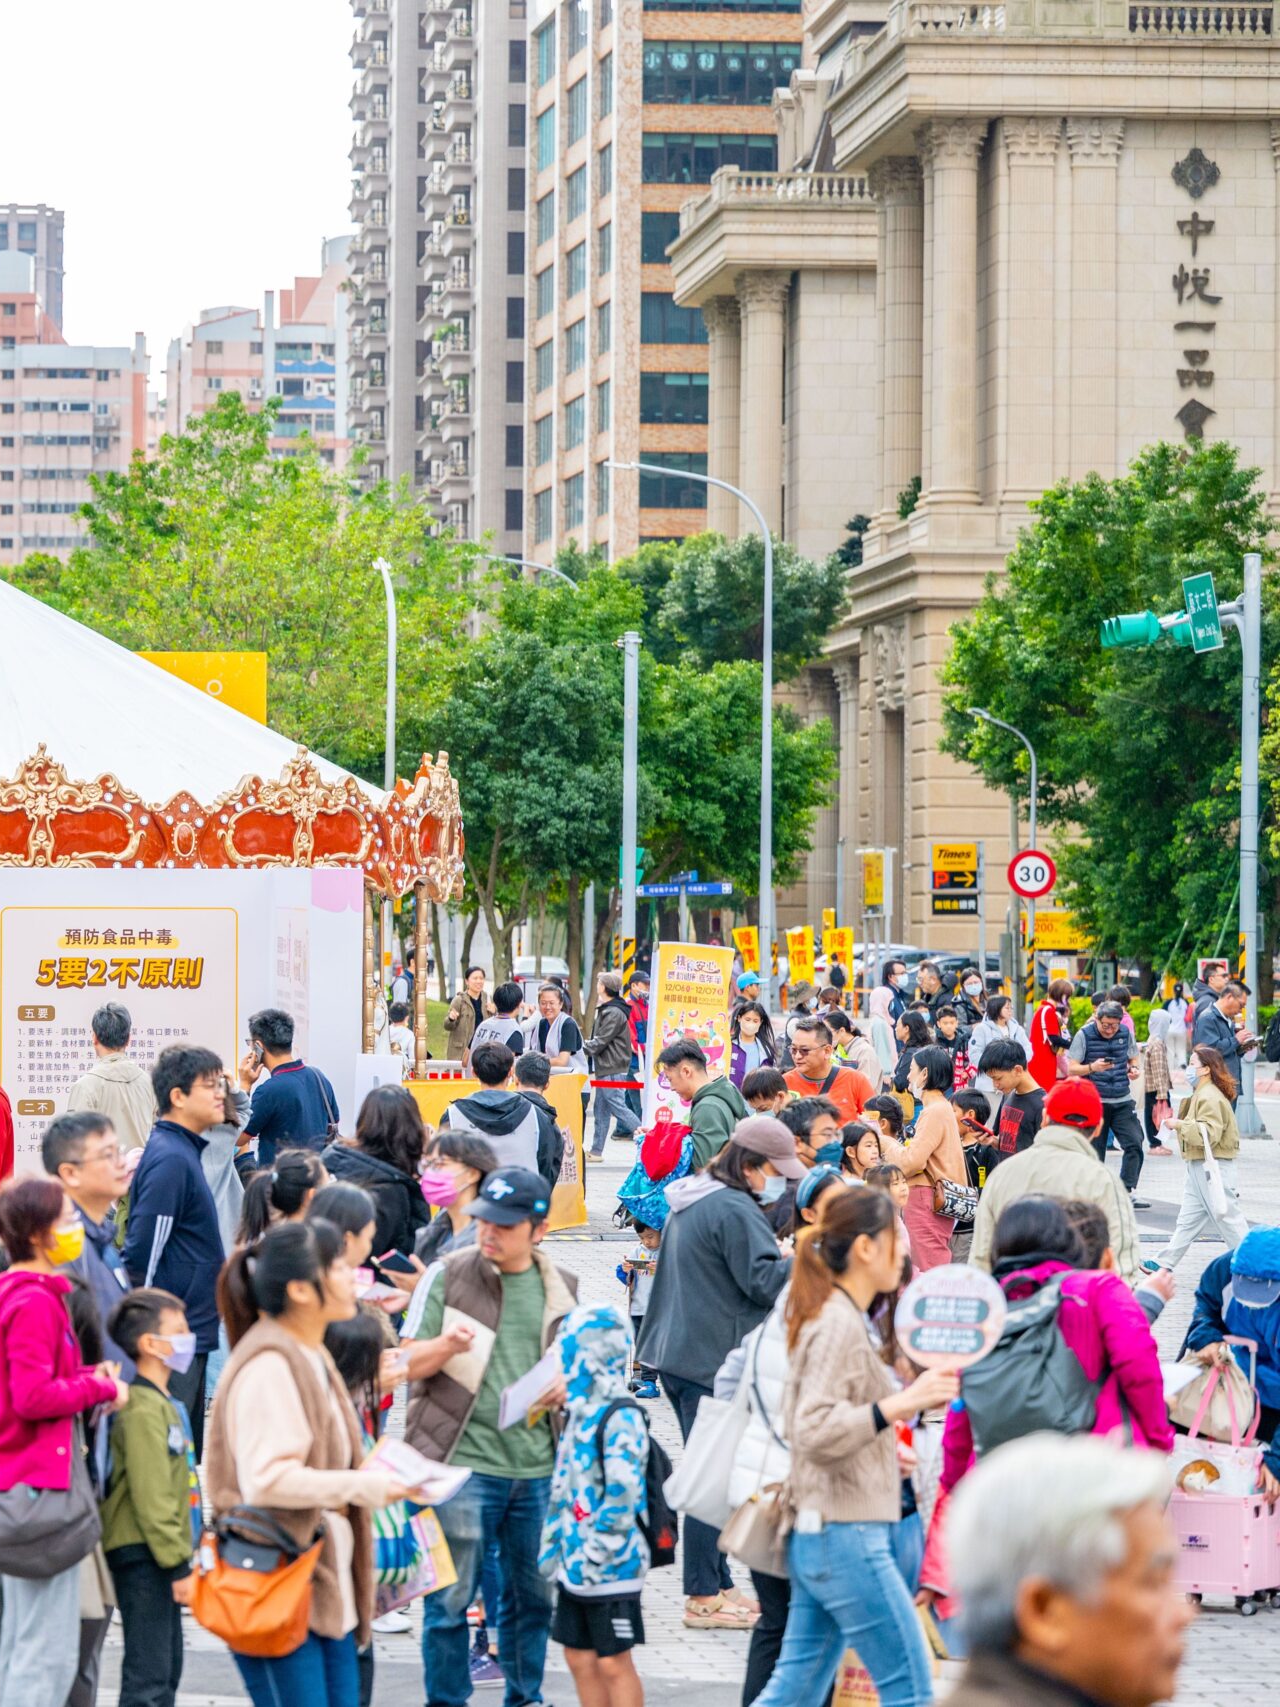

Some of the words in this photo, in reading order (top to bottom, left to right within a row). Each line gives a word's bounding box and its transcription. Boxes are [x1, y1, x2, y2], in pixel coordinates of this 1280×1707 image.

[1172, 211, 1223, 441] 中悅一品會
[937, 848, 972, 858] Times
[1020, 866, 1045, 883] 30
[65, 929, 172, 945] 預防食品中毒
[36, 957, 204, 989] 5要2不原則
[24, 1008, 48, 1019] 五要
[24, 1102, 49, 1113] 二不
